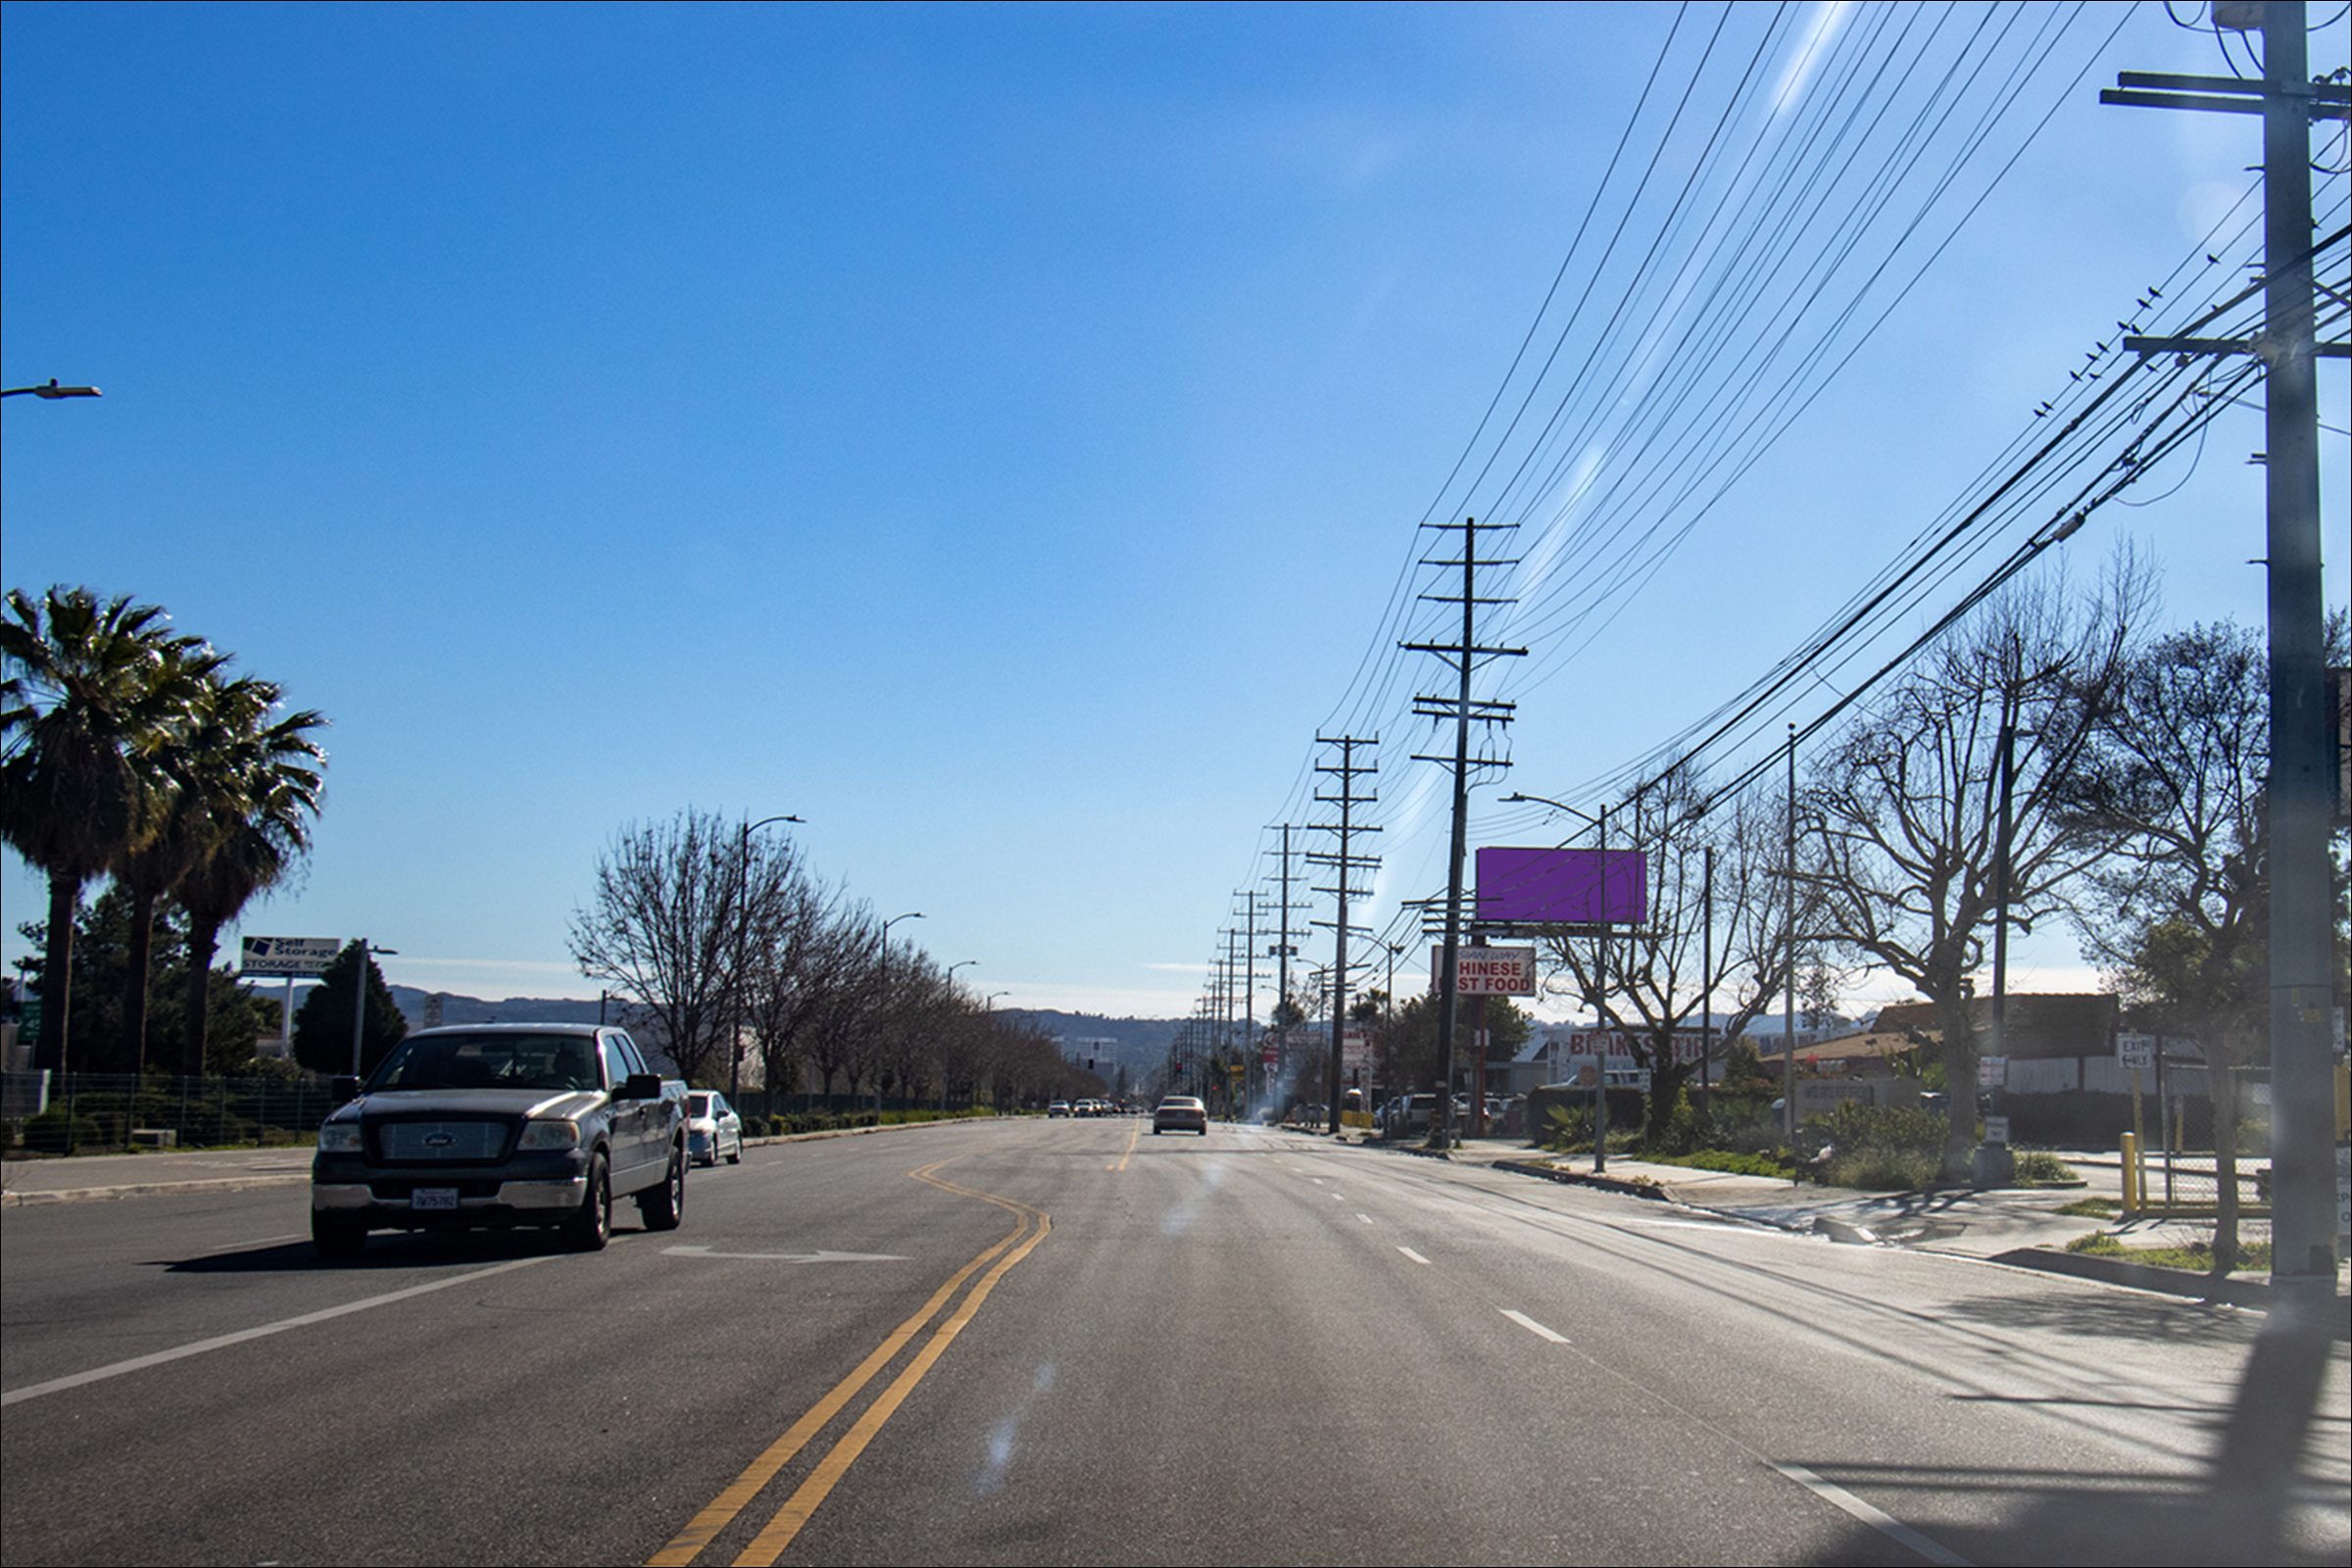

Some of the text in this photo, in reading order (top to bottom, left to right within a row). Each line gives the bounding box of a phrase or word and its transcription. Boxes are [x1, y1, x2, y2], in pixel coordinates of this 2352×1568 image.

[275, 938, 305, 948] Self
[275, 945, 337, 958] Storage
[1458, 951, 1519, 961] SIAN WAY
[243, 960, 303, 970] STORAGE
[1459, 962, 1522, 976] HINESE
[1485, 978, 1531, 992] FOOD
[1571, 1033, 1656, 1057] BKS
